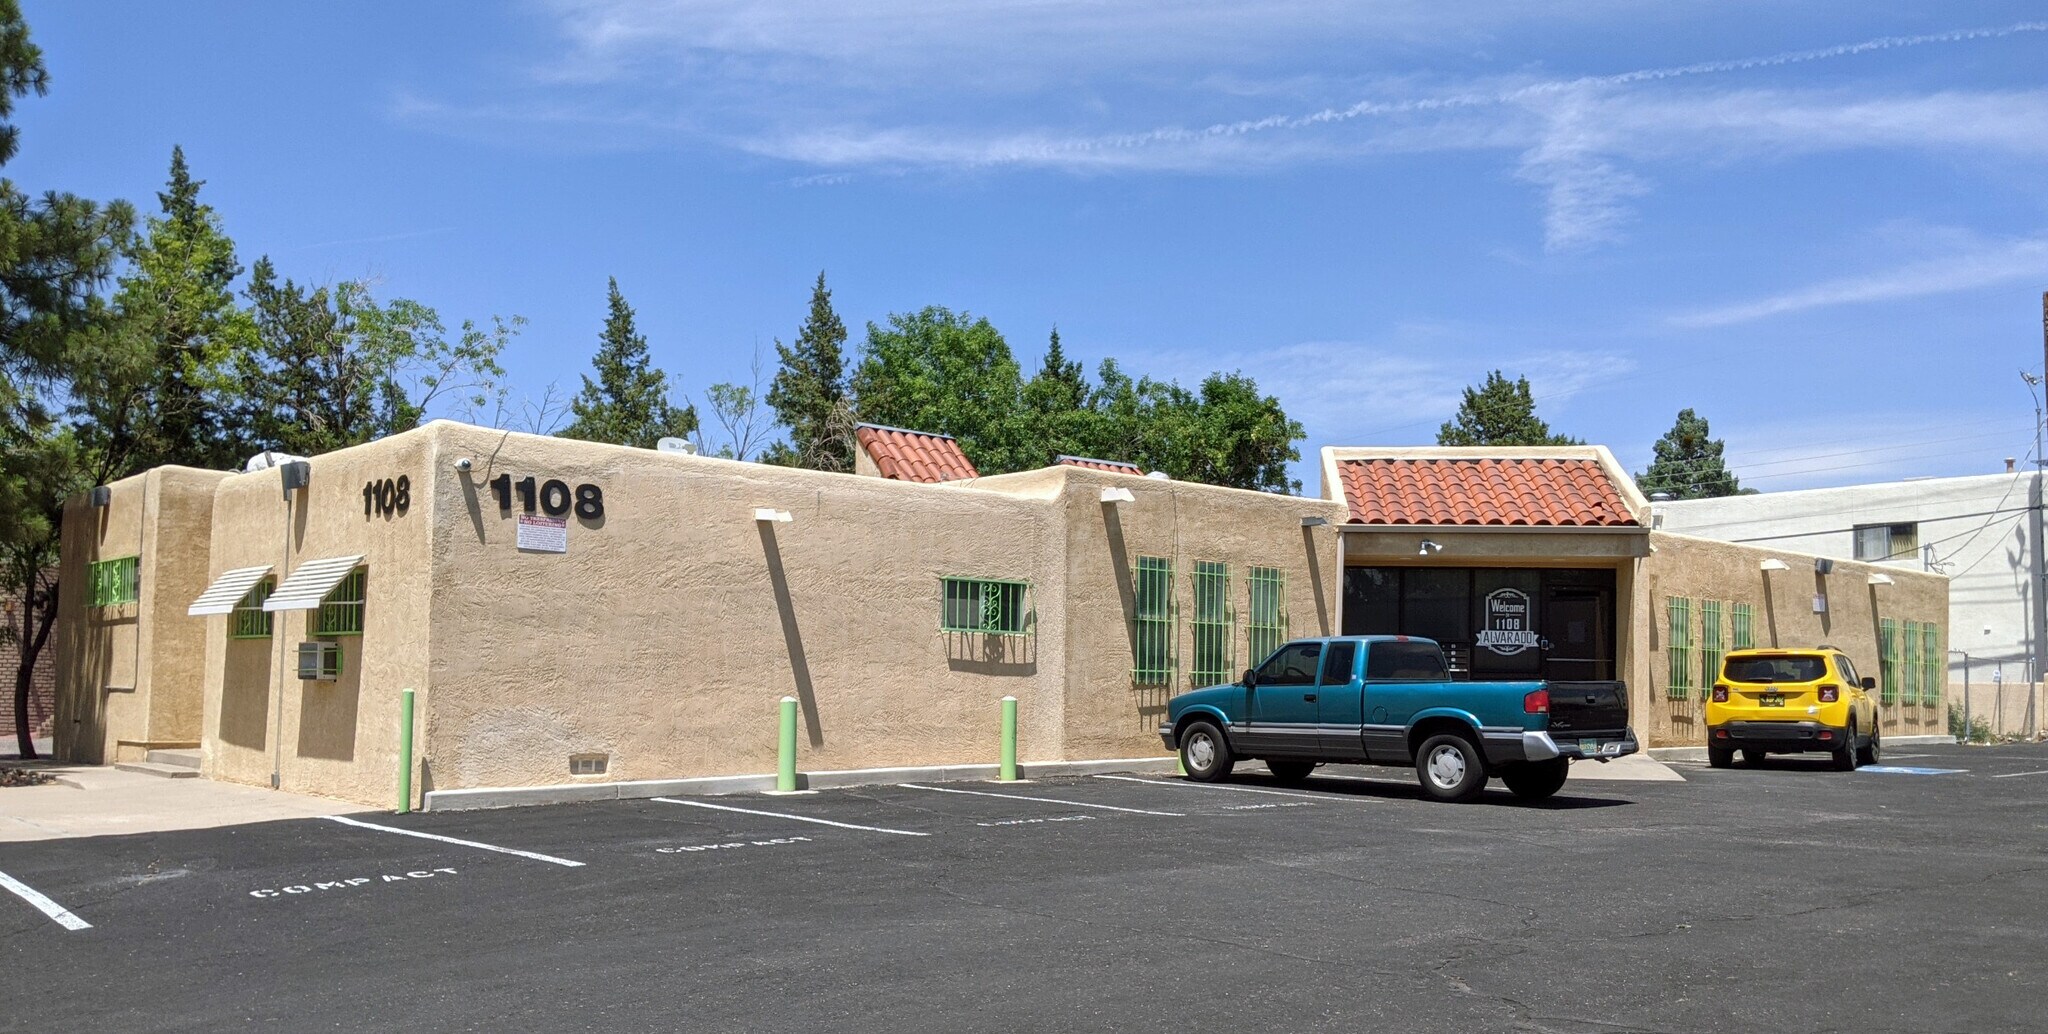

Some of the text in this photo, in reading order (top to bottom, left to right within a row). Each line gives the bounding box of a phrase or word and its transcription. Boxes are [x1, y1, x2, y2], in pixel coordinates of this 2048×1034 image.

[363, 475, 410, 516] 1108
[490, 473, 605, 520] 1108
[1490, 599, 1525, 613] Welcome
[1496, 618, 1520, 630] 1108
[1483, 631, 1532, 644] ALVARADO
